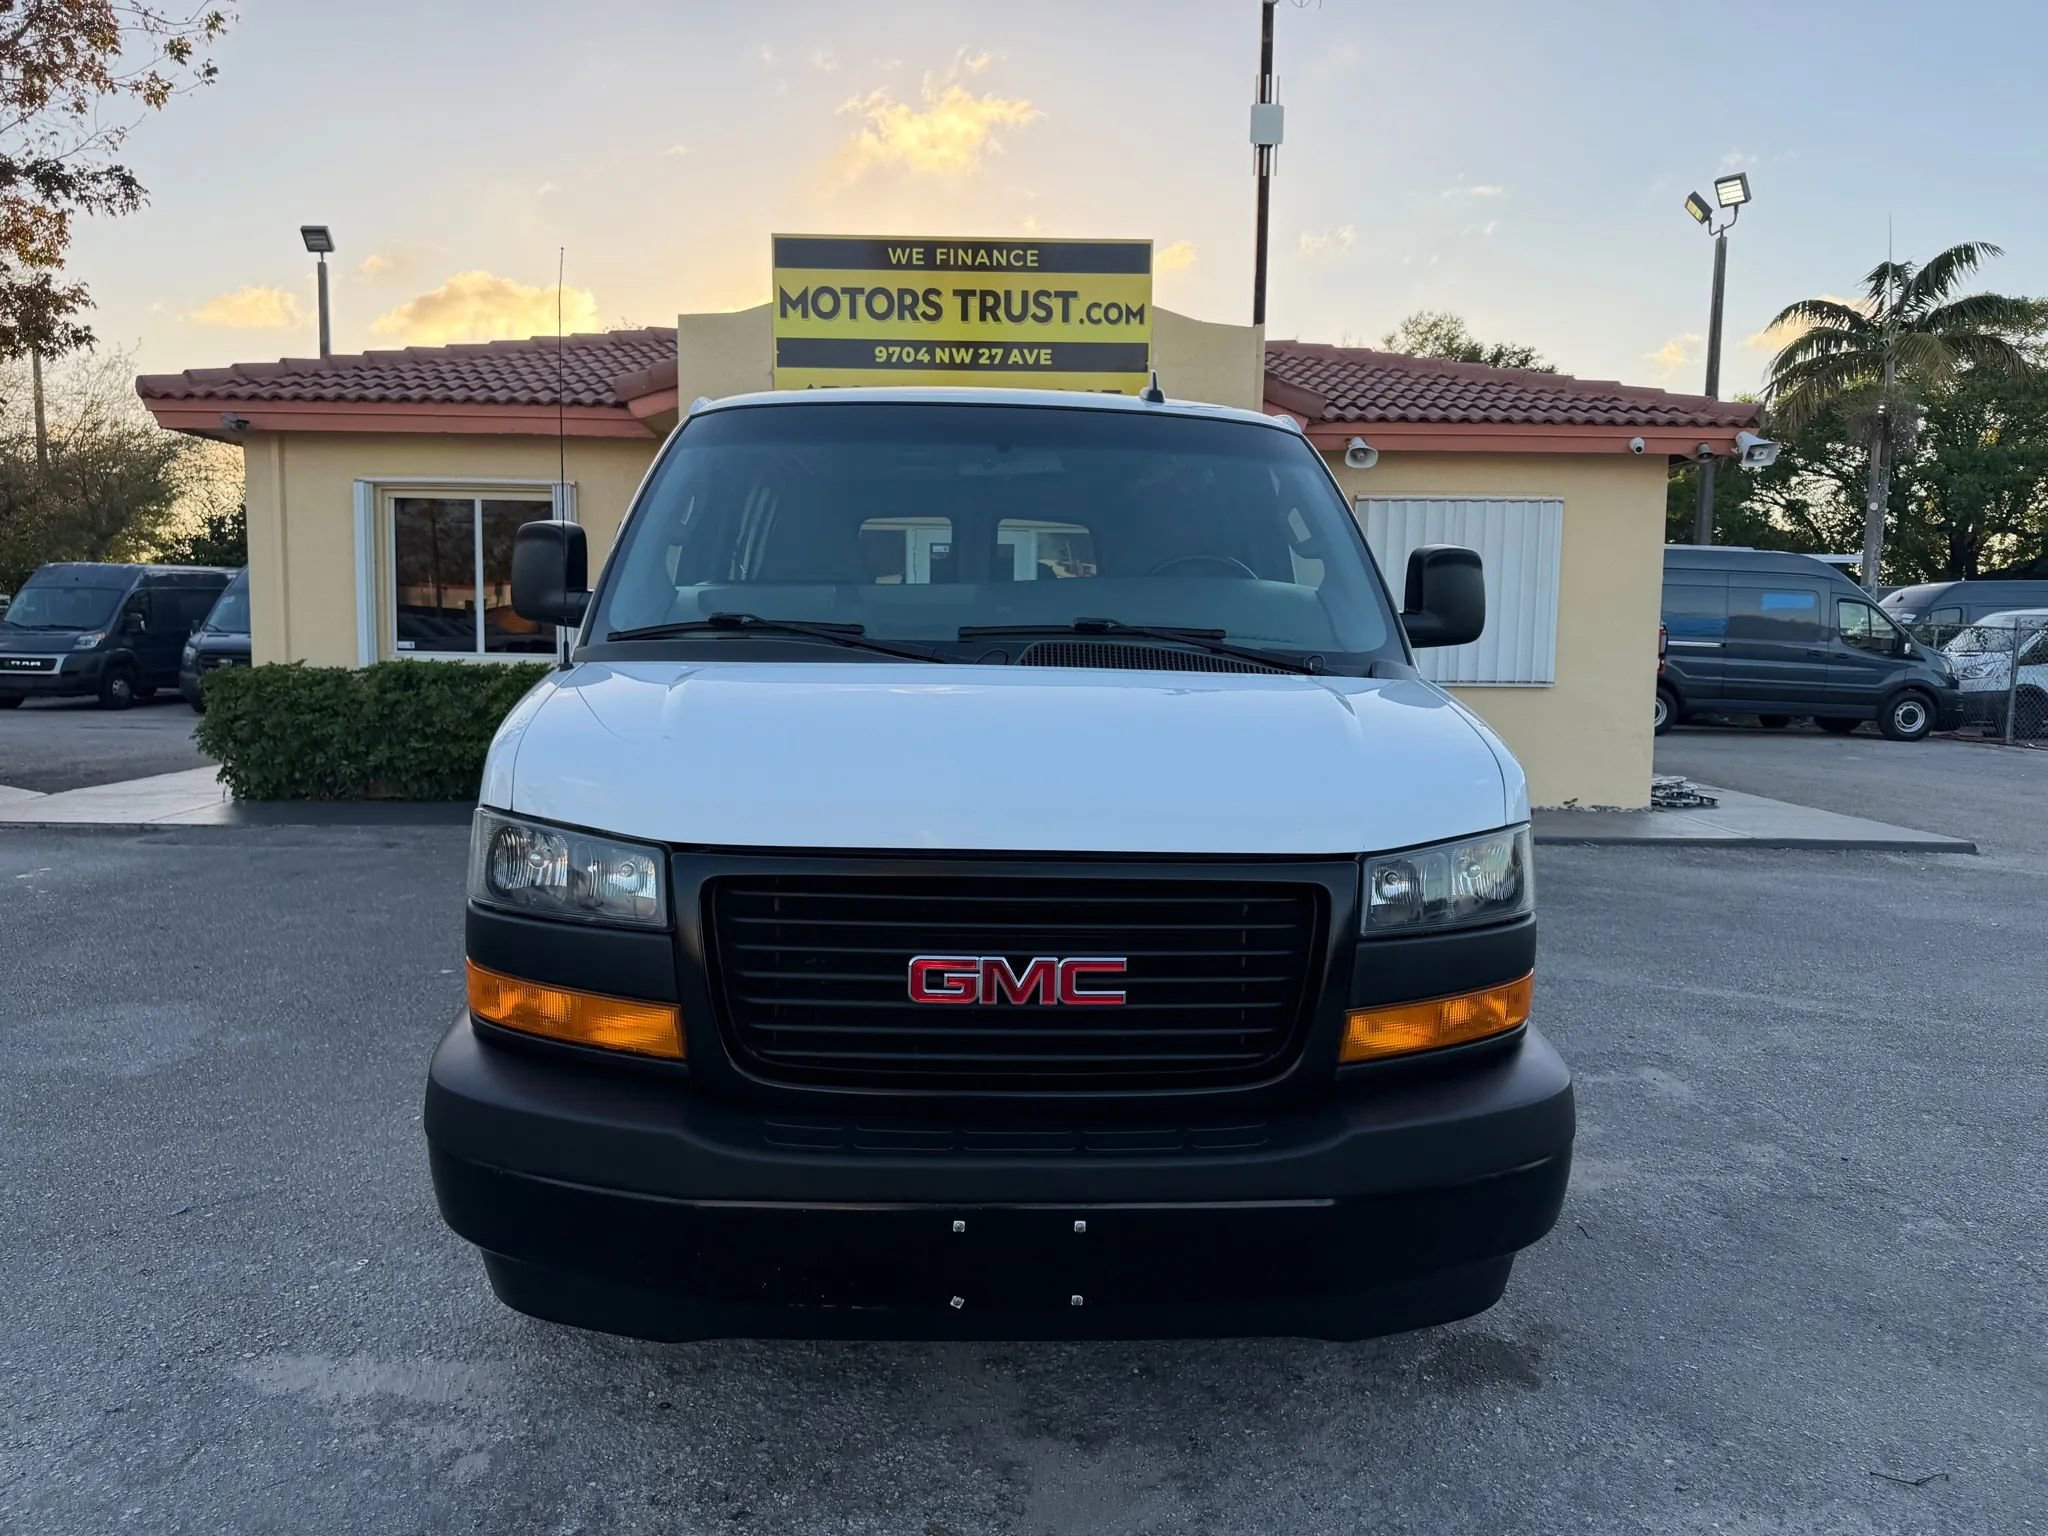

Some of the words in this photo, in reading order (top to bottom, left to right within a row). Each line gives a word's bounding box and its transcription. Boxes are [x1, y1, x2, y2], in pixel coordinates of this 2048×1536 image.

[888, 247, 925, 265] WE
[936, 248, 1039, 267] FINANCE
[779, 285, 943, 323] MOTORS
[874, 346, 930, 364] 9704
[935, 347, 973, 364] NW
[978, 348, 1003, 365] 27
[1007, 348, 1052, 365] AVE
[908, 955, 1127, 1005] GMC
